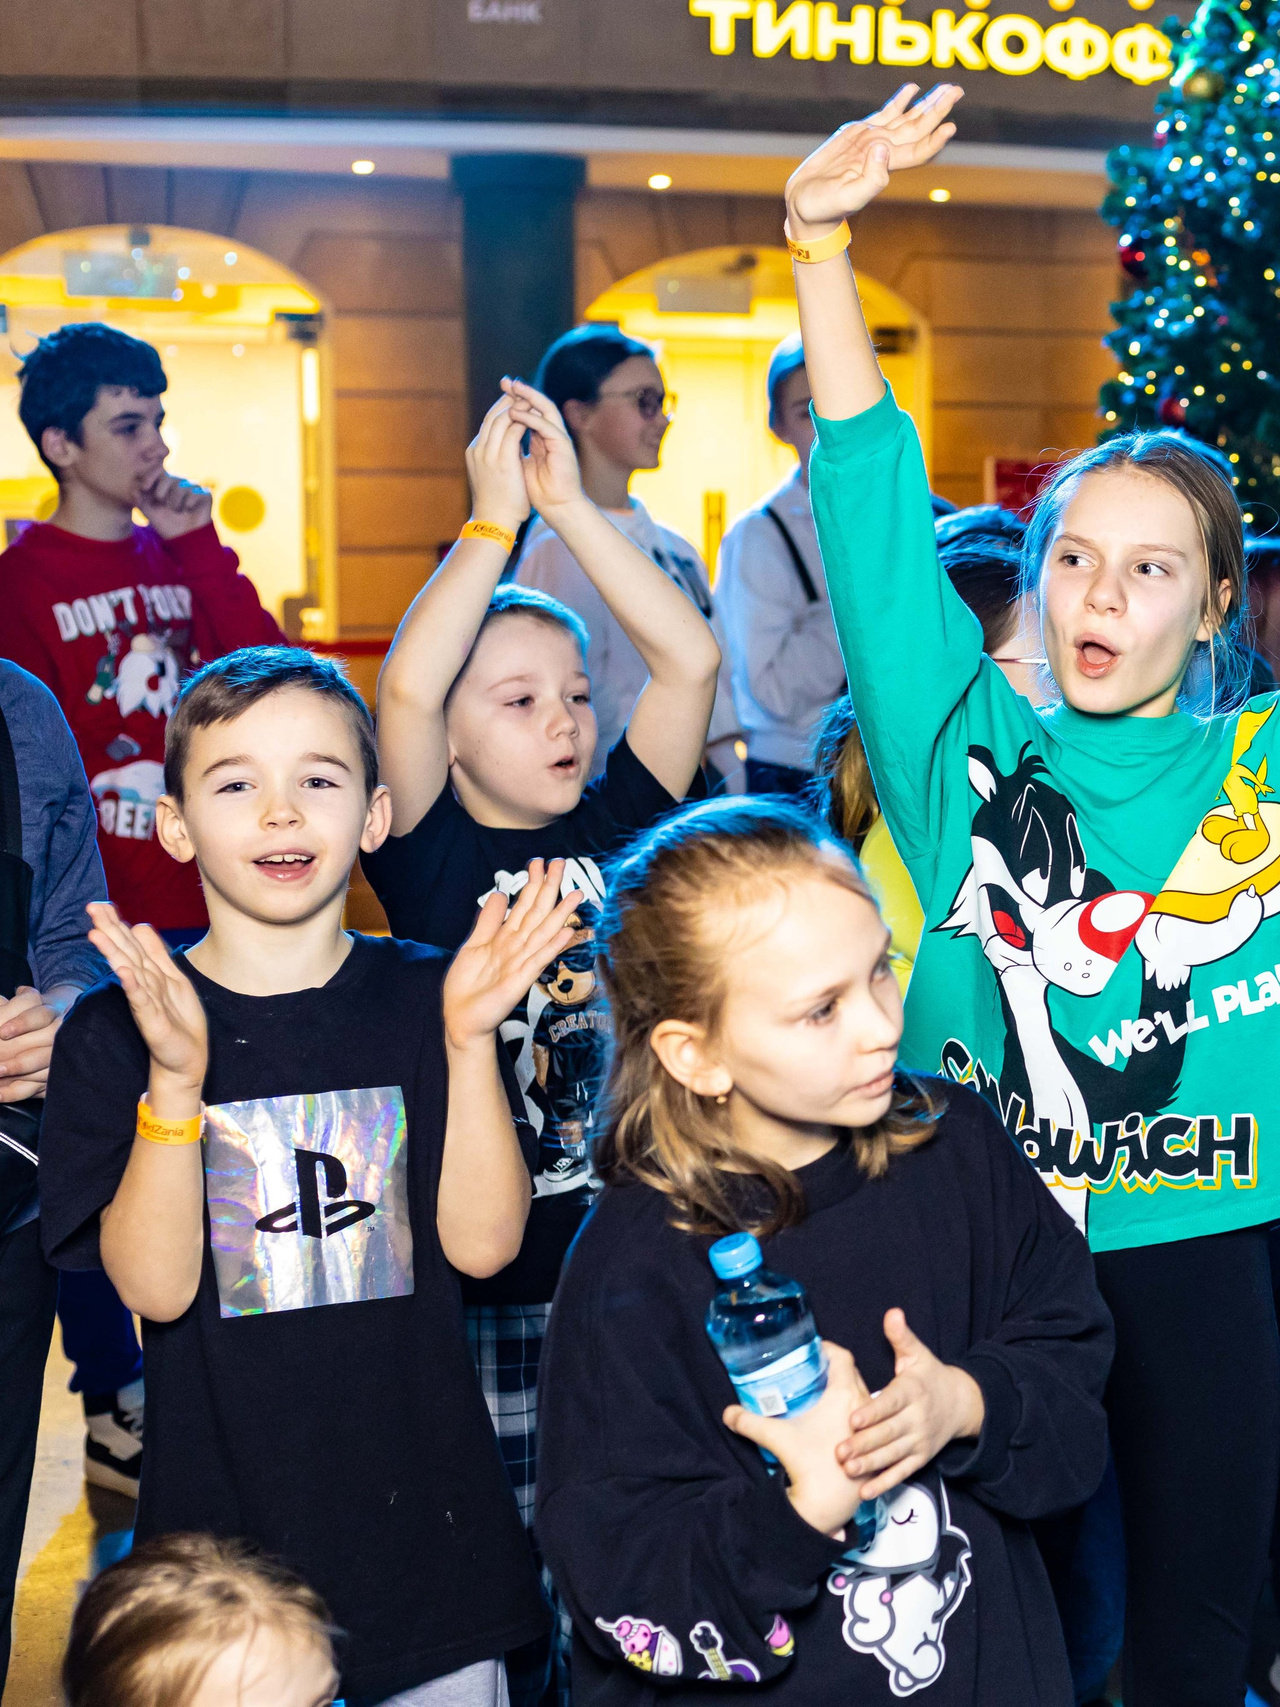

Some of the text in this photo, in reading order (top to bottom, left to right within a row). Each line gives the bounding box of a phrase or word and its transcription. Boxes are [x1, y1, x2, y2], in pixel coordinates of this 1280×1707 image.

[468, 0, 541, 23] БАНК
[689, 0, 1174, 86] ТИНЬКОФФ
[52, 586, 139, 642] DON'T
